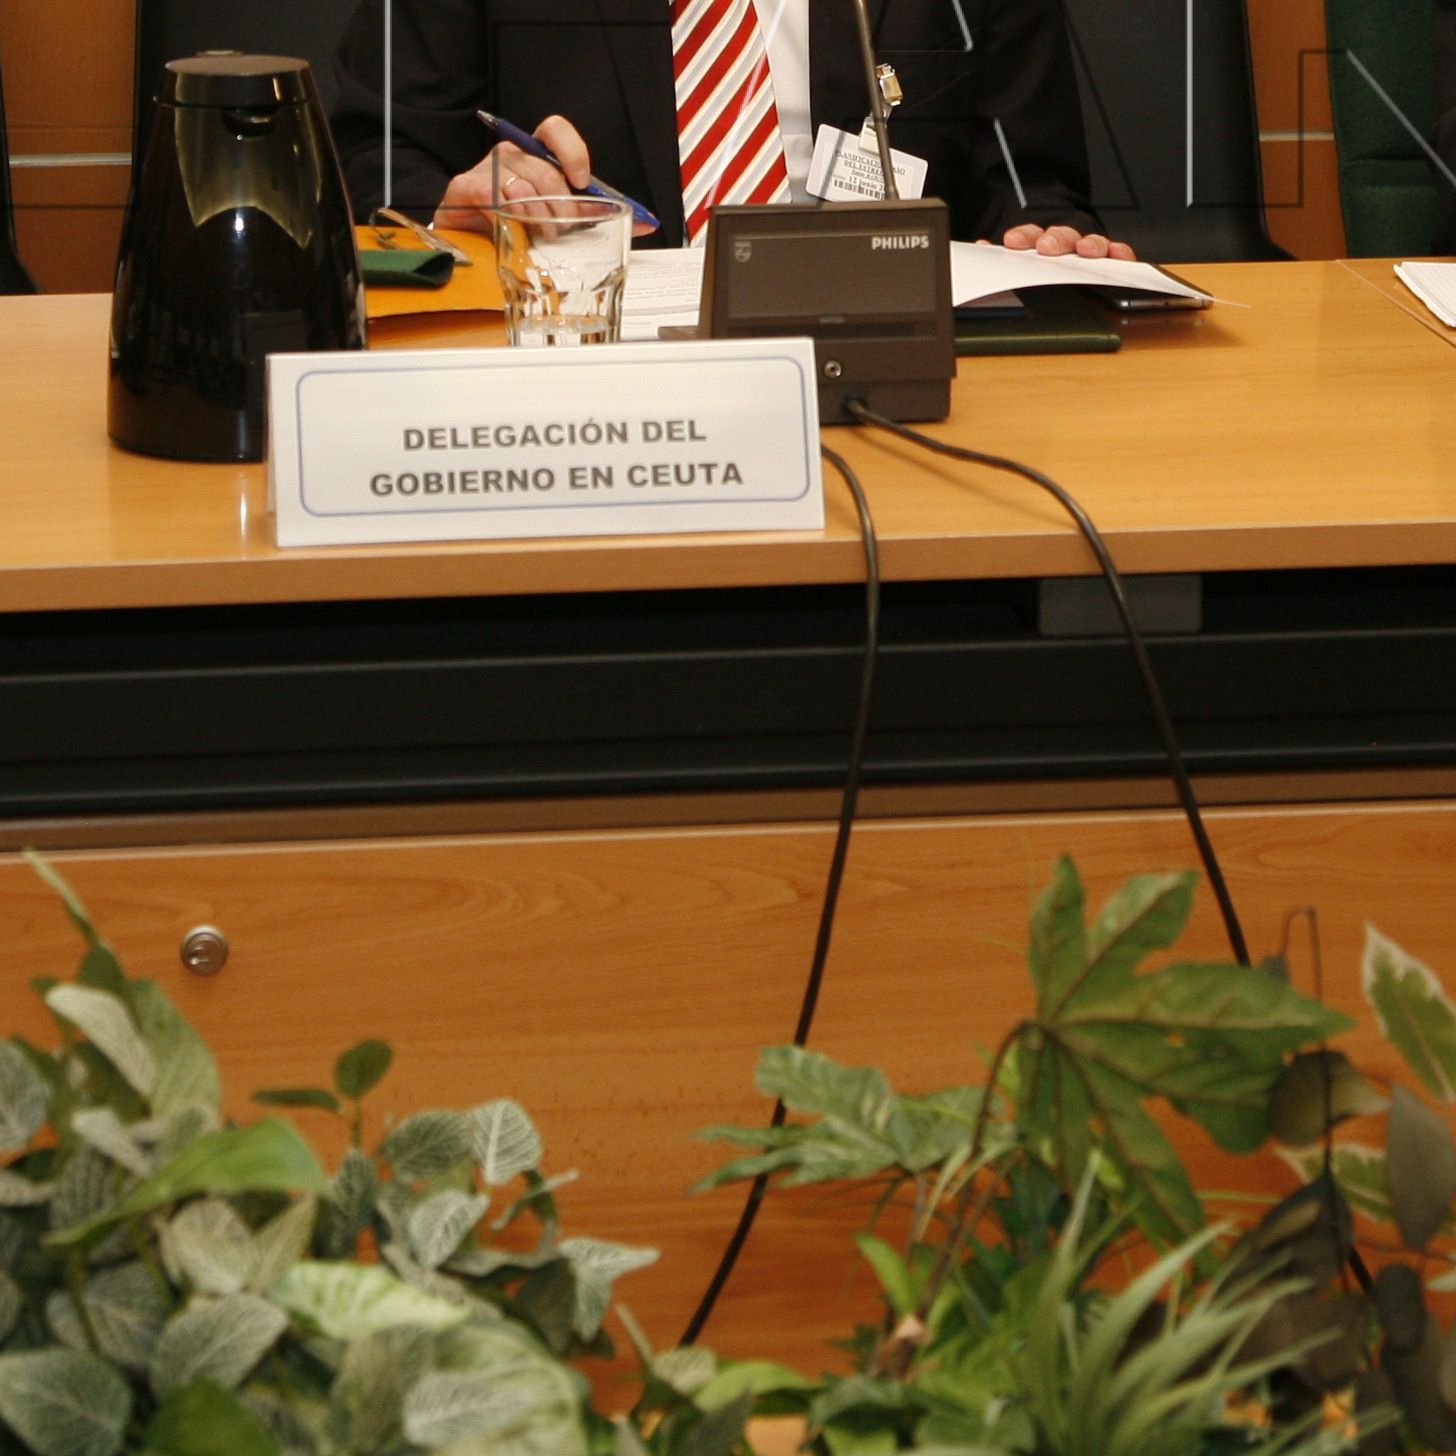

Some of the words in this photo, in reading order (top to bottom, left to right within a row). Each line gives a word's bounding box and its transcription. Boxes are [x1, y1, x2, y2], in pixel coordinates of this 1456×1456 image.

[871, 236, 930, 250] PHILIPS
[404, 418, 627, 451] DELEGACIÓN
[642, 420, 706, 443] DEL
[370, 468, 555, 496] GOBIERNO
[569, 466, 613, 489] EN
[627, 462, 743, 487] CEUTA
